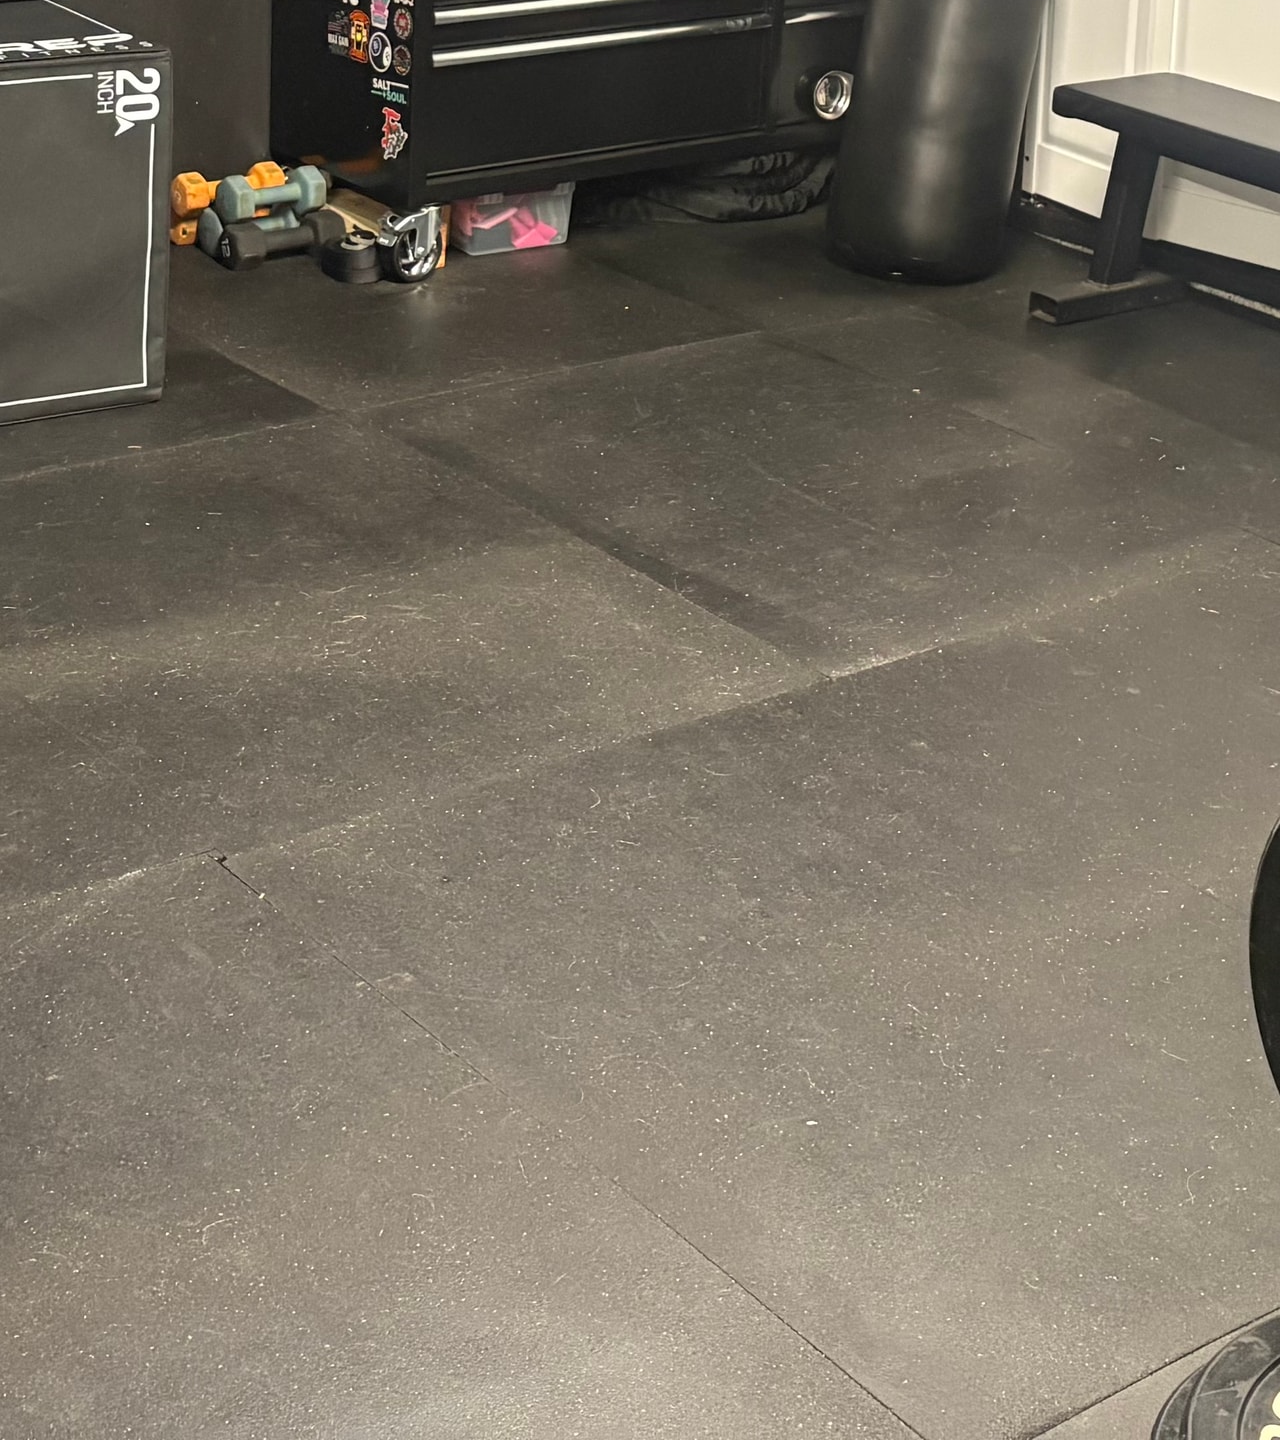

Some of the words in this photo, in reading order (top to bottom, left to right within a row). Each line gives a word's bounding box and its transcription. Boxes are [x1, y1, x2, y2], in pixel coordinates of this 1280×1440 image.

[96, 70, 114, 114] INCH
[115, 67, 161, 122] 20
[372, 77, 391, 91] SALT
[221, 237, 231, 258] 12
